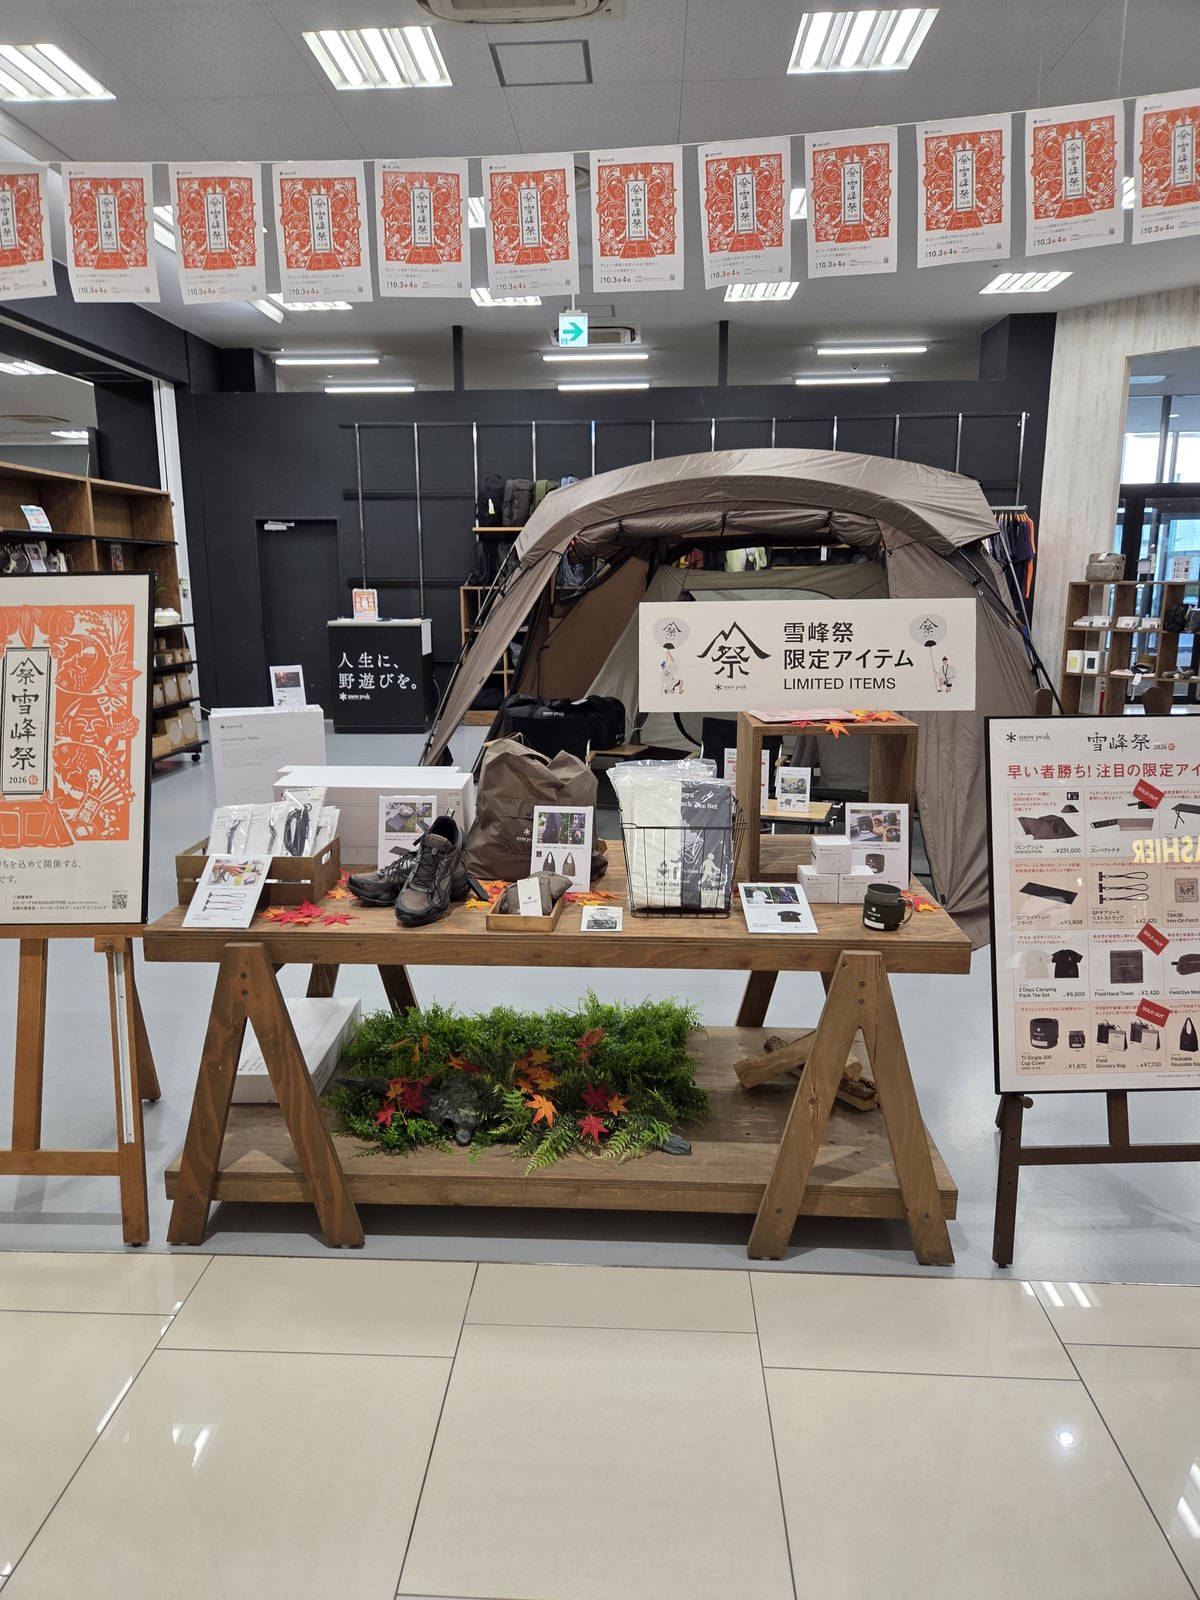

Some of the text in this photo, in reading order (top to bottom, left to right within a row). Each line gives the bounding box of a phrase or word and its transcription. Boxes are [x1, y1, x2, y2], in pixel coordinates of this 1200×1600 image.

[784, 622, 854, 644] 雪峰祭
[338, 652, 399, 669] 人生に、
[784, 649, 914, 670] 限定アイテム
[339, 673, 417, 690] 野遊びを。
[784, 678, 896, 690] LIMITED ITEMS
[10, 689, 40, 771] 雪峰祭
[1036, 733, 1050, 741] peak
[1087, 732, 1150, 752] 雪峰祭
[1137, 787, 1158, 802] SOLD OUT
[0, 860, 82, 868] ちを込めて開催する、
[1143, 930, 1155, 941] SOLD
[1142, 1006, 1164, 1018] SOLD OUT
